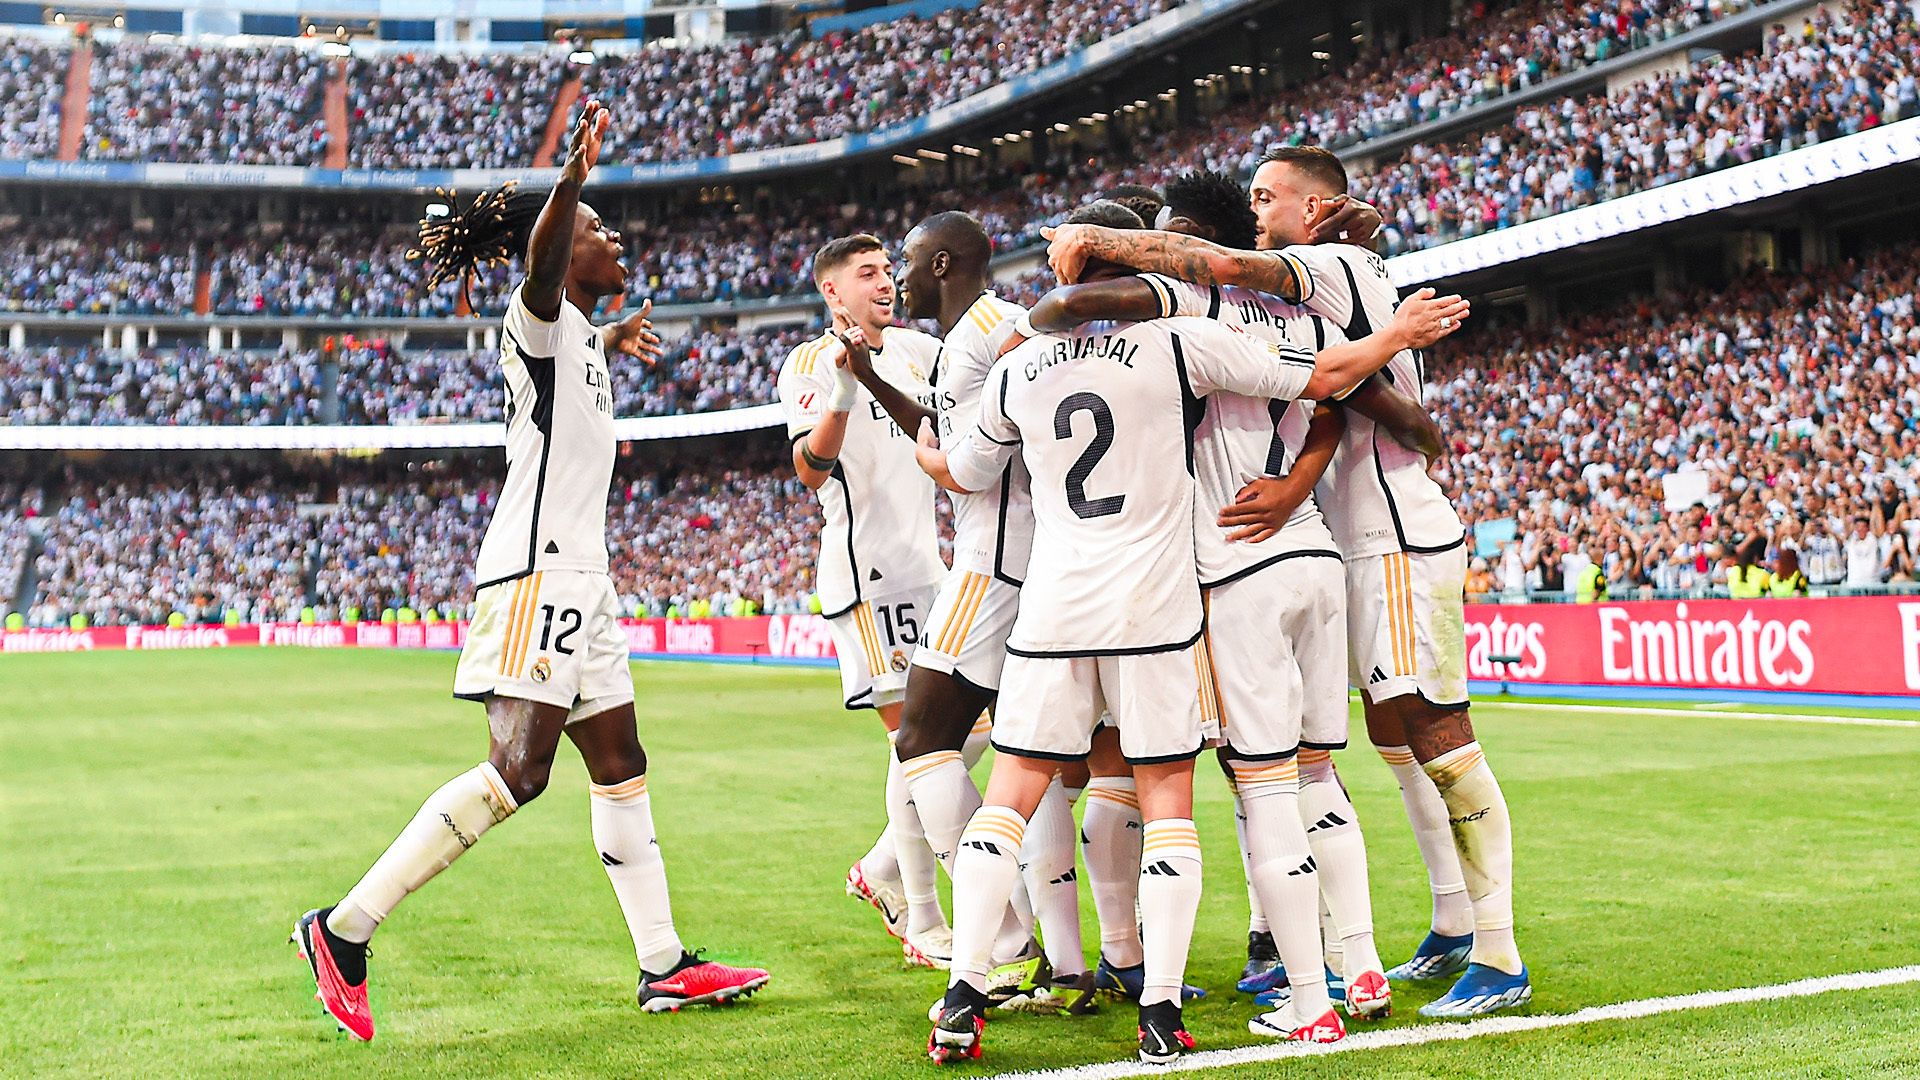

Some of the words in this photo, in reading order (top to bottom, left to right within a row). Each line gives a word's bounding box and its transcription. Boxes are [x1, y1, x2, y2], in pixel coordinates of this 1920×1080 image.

[1274, 314, 1291, 343] R.
[1024, 335, 1139, 382] CARVAJAL
[1054, 391, 1126, 519] 2
[0, 627, 95, 652] mirates
[125, 622, 229, 650] Emirates
[539, 603, 581, 656] 12
[877, 603, 919, 647] 15
[1598, 601, 1815, 686] Emirates
